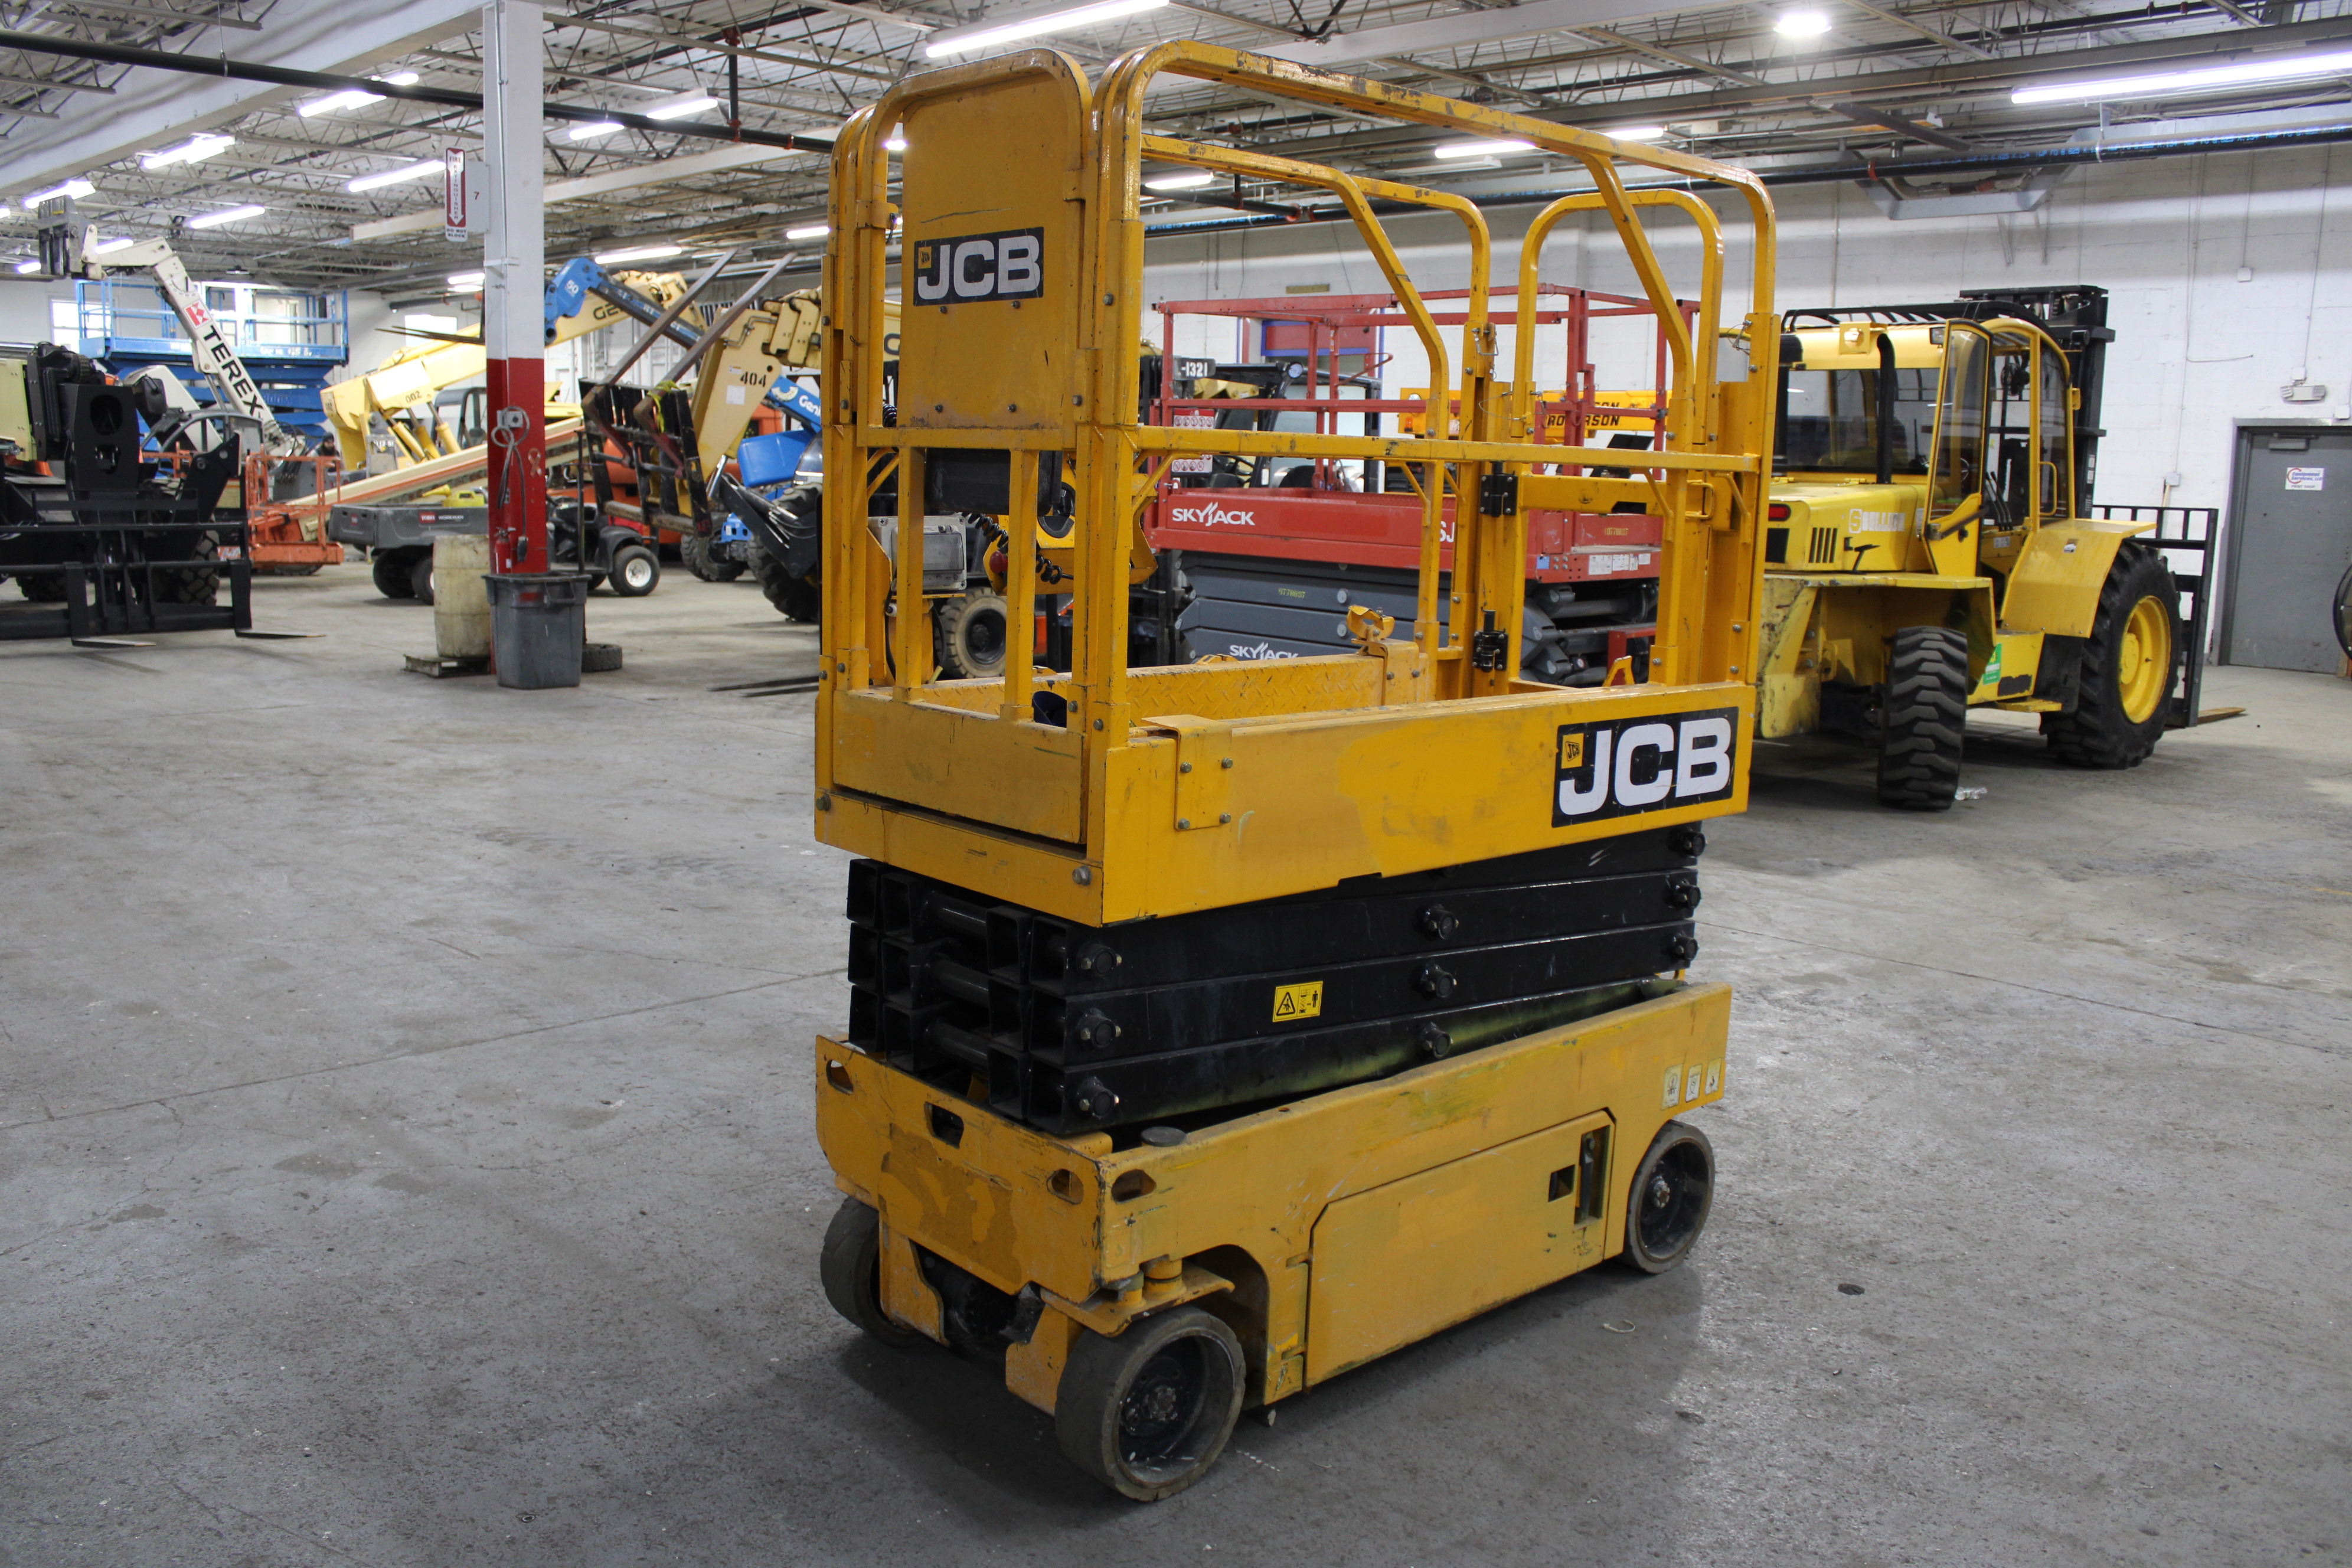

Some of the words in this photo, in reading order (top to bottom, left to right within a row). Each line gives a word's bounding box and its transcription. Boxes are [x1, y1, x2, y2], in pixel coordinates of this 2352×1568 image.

[917, 235, 1041, 300] JCB
[204, 325, 263, 416] TEREX
[740, 371, 766, 387] 404
[405, 390, 422, 403] 002
[799, 394, 821, 417] Geni
[1172, 502, 1256, 527] SKYJACK
[1566, 742, 1580, 759] JCB
[1559, 717, 1732, 815] JCB
